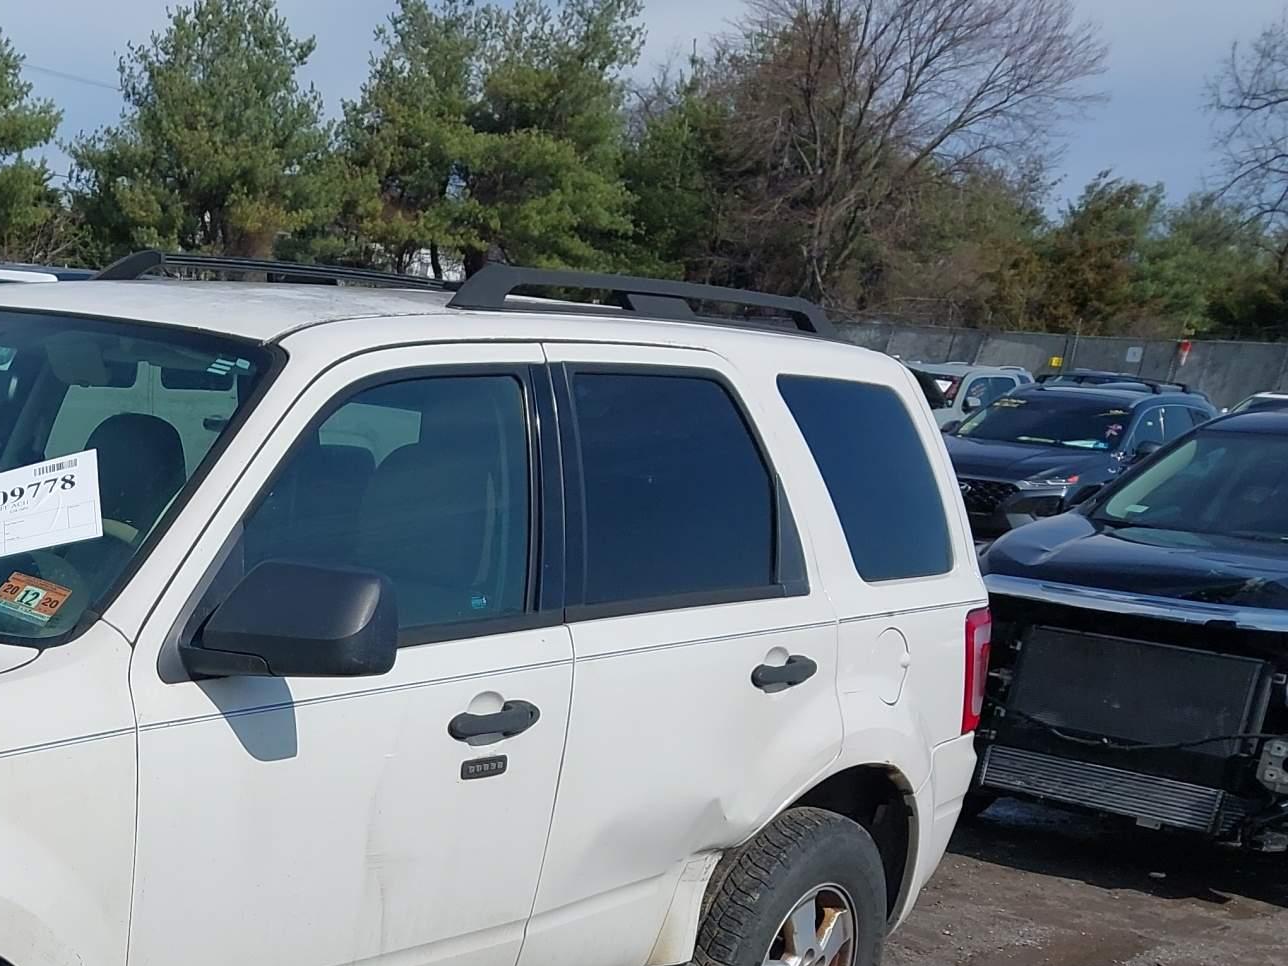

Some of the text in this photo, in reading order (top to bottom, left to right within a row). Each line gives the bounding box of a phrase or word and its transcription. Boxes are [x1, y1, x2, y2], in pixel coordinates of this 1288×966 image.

[3, 584, 59, 608] 20 12 20
